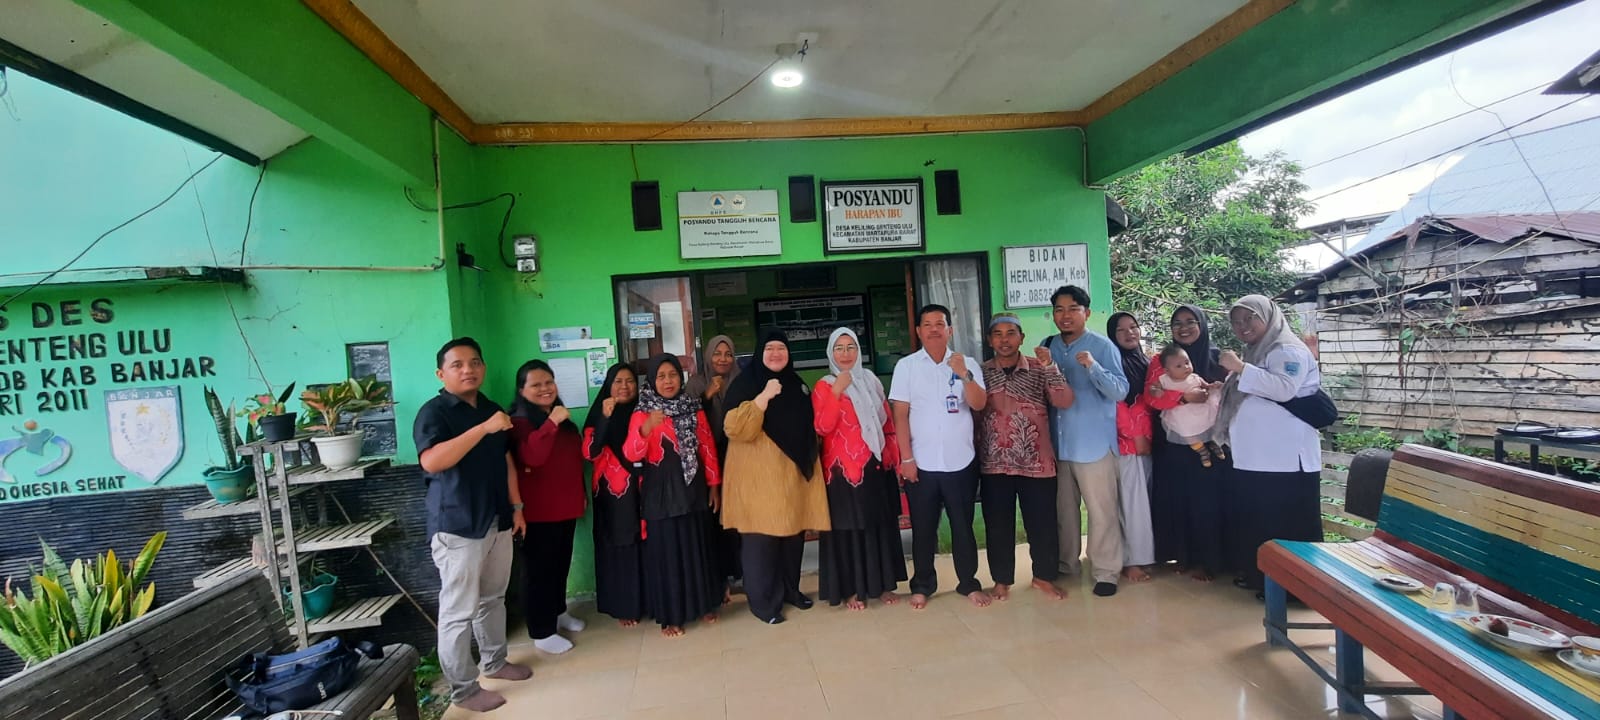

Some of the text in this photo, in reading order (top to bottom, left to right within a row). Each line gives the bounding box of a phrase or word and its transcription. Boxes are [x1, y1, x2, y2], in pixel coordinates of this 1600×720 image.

[833, 189, 913, 207] POSYANDU
[845, 208, 903, 219] HARAPAN IBU
[1029, 248, 1066, 263] BIDAN
[1010, 266, 1086, 284] HERLINA, AM, Keb
[1009, 289, 1021, 303] HP
[1028, 288, 1056, 303] 08525
[31, 298, 115, 329] DES
[117, 328, 171, 356] ULU
[41, 365, 97, 388] KAB
[111, 356, 216, 384] BANJAR
[36, 389, 89, 413] 2011
[110, 389, 173, 401] BANJAR
[75, 475, 126, 491] SEHAT
